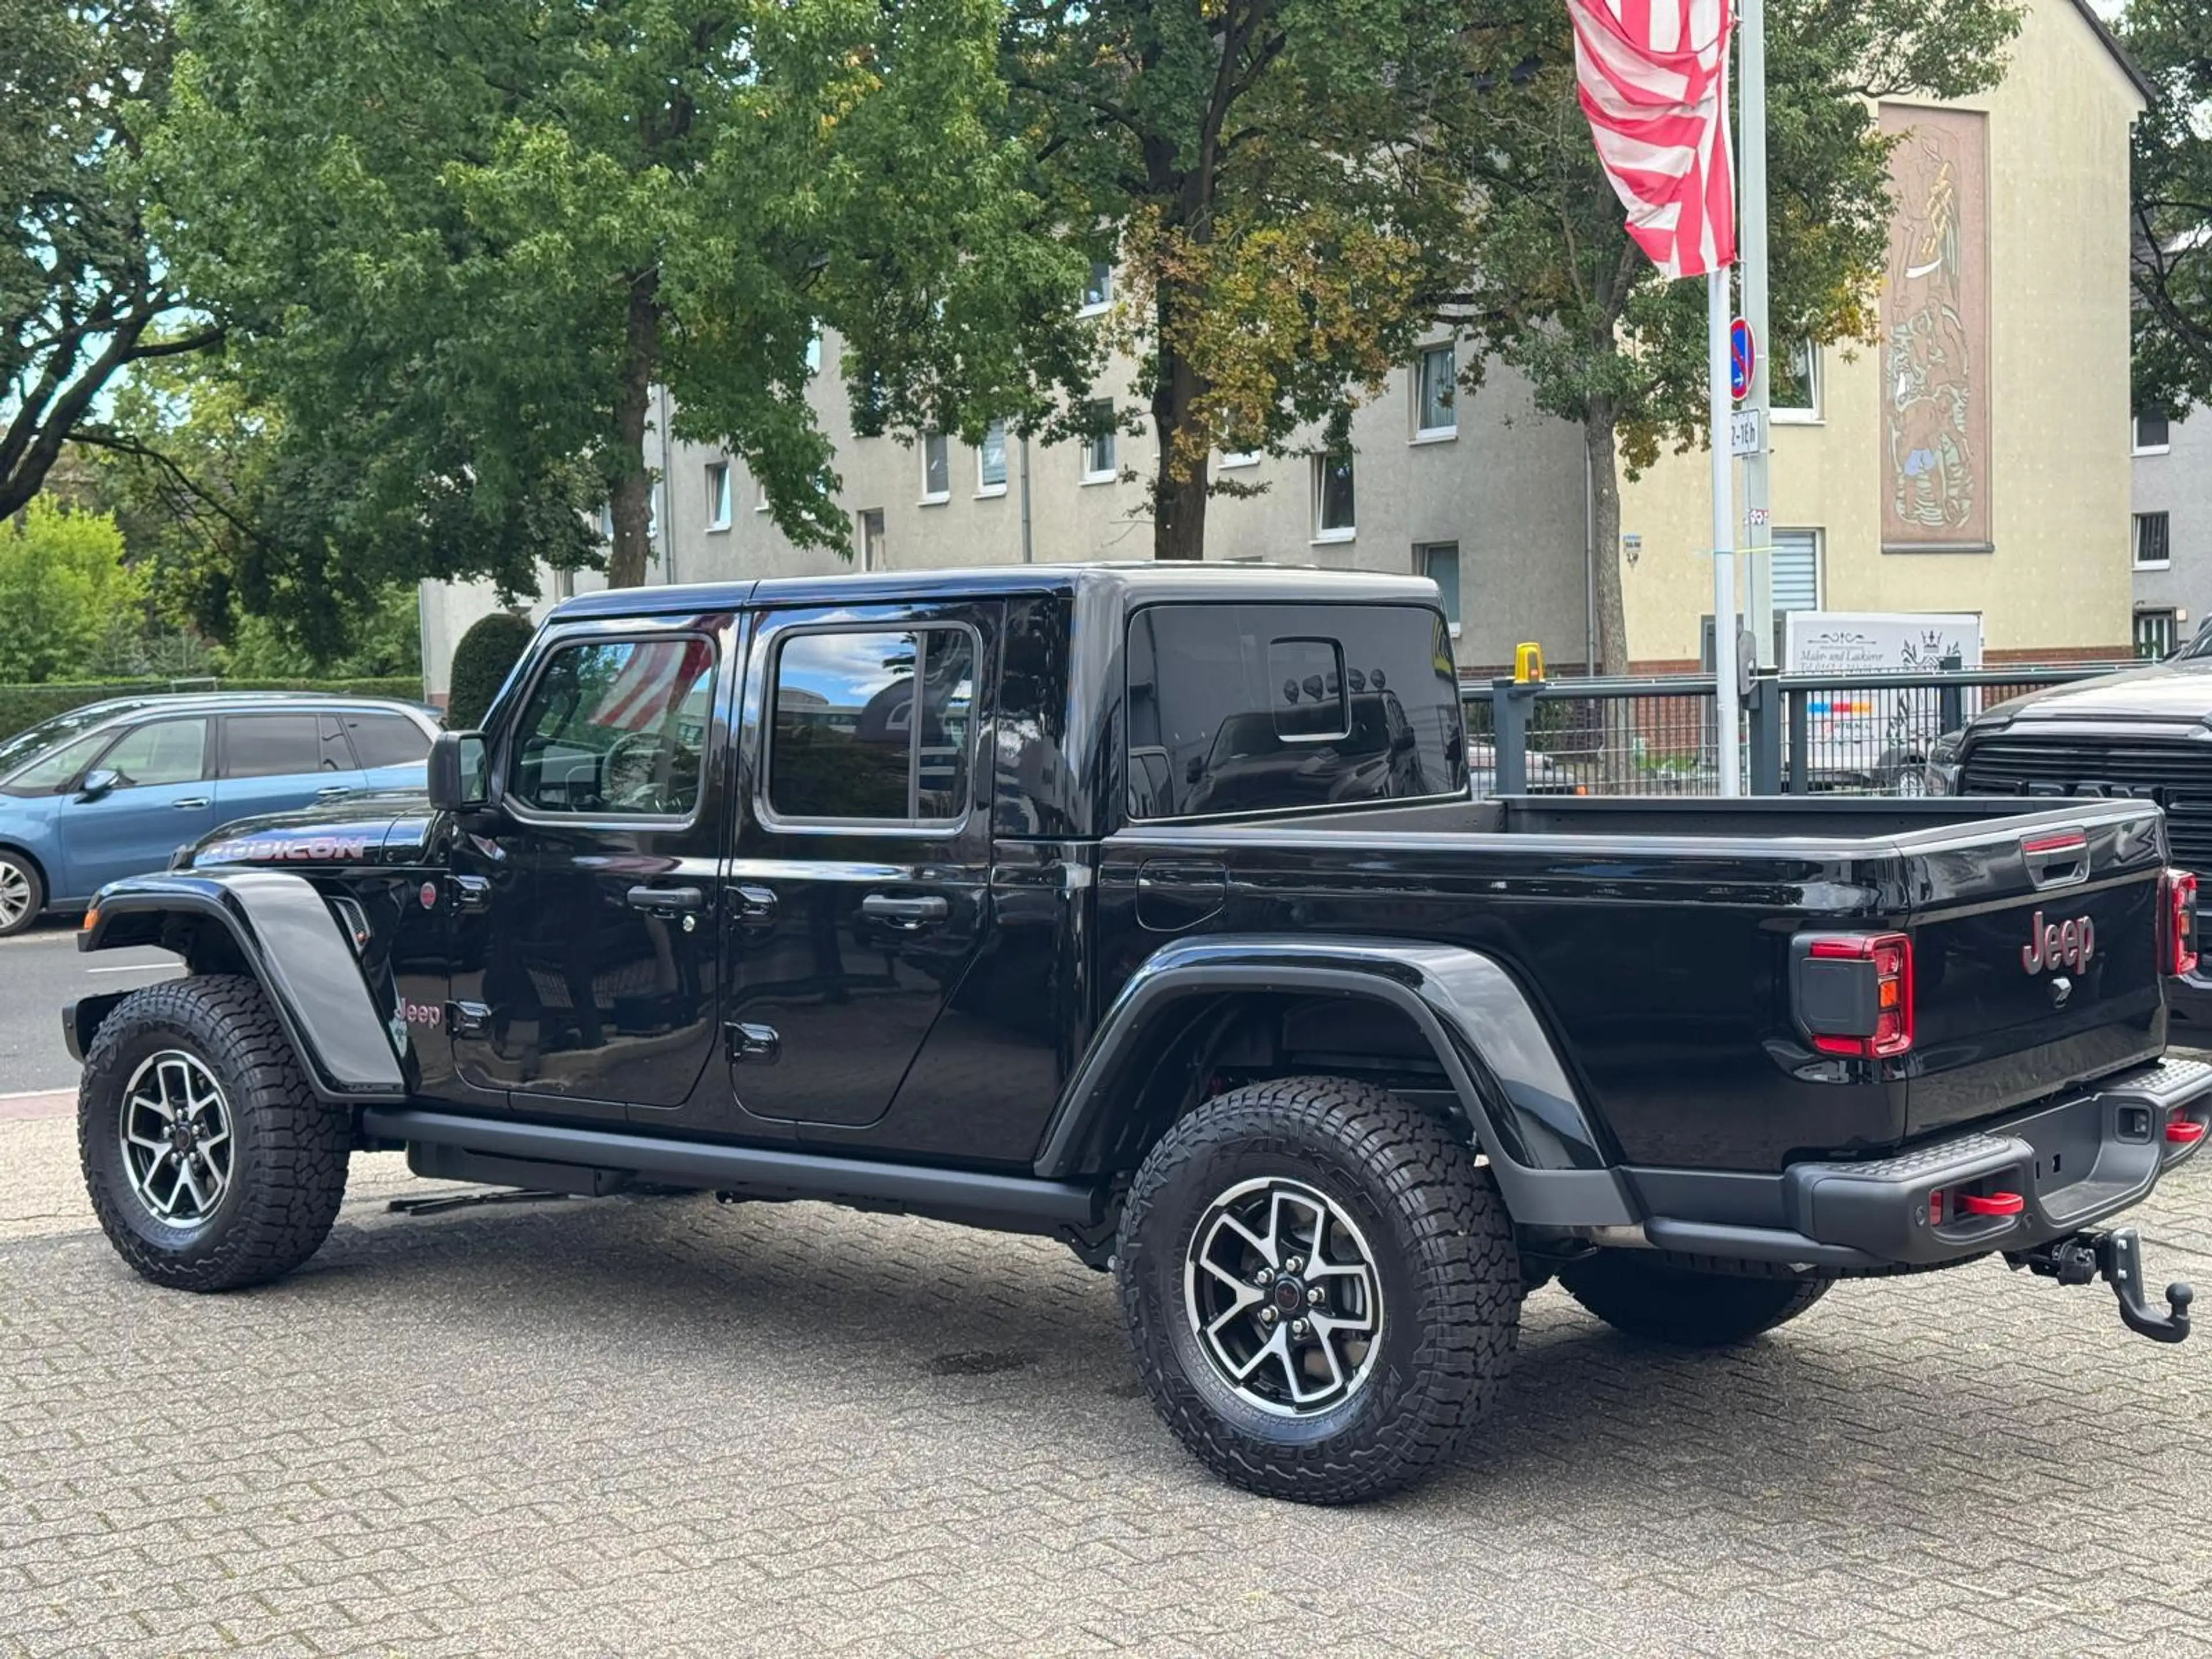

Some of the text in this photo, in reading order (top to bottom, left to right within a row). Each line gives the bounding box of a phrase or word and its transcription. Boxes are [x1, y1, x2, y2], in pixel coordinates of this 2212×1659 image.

[206, 836, 366, 860] RUBICON
[2022, 911, 2094, 975] Jeep
[394, 997, 441, 1030] Jeep
